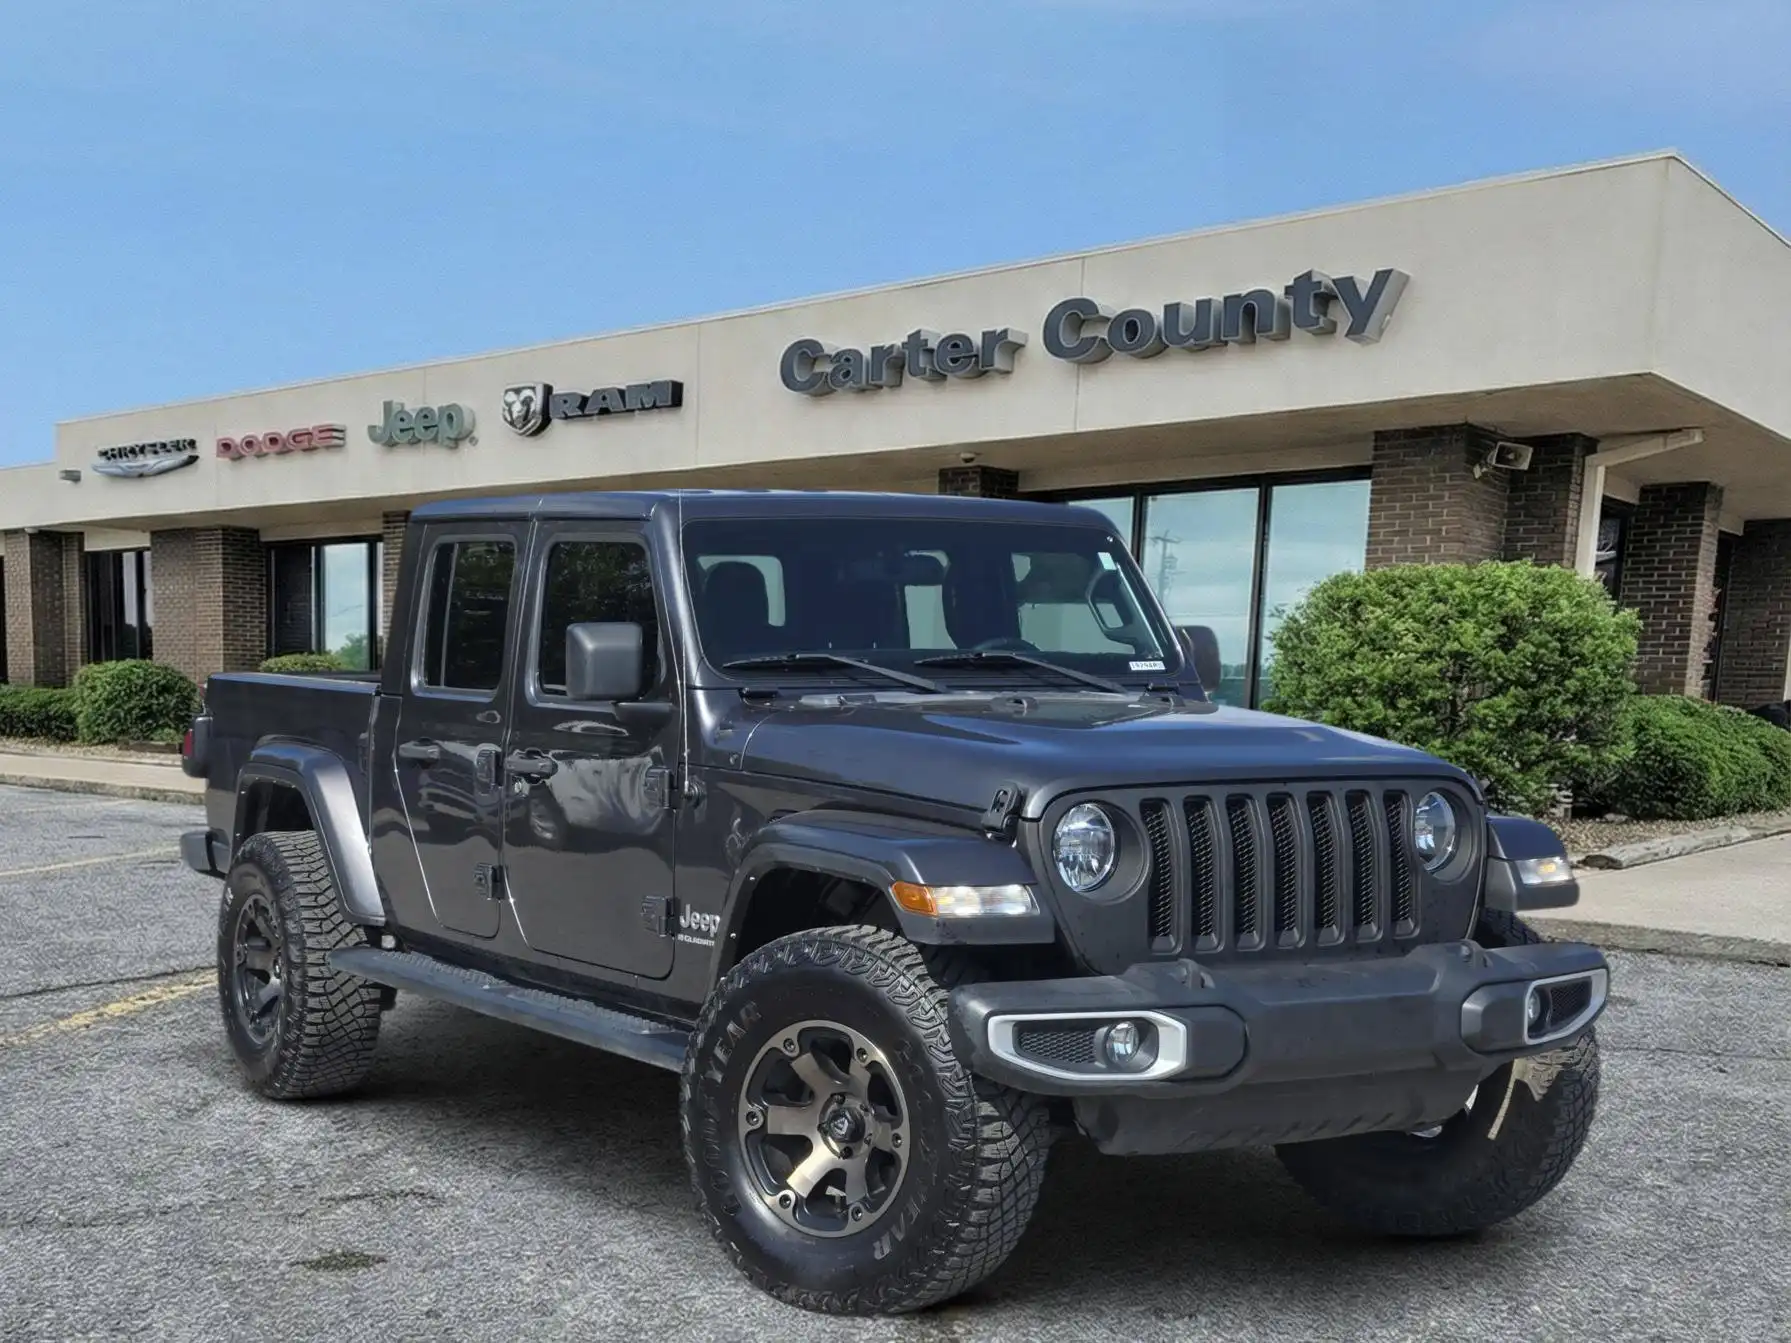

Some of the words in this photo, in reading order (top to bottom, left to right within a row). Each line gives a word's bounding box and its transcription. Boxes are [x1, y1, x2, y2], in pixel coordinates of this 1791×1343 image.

[779, 327, 1022, 396] Carter
[1042, 268, 1406, 363] County
[551, 380, 682, 420] RAM
[216, 424, 345, 459] DODGE
[368, 400, 472, 448] Jeep
[679, 904, 721, 937] Jeep
